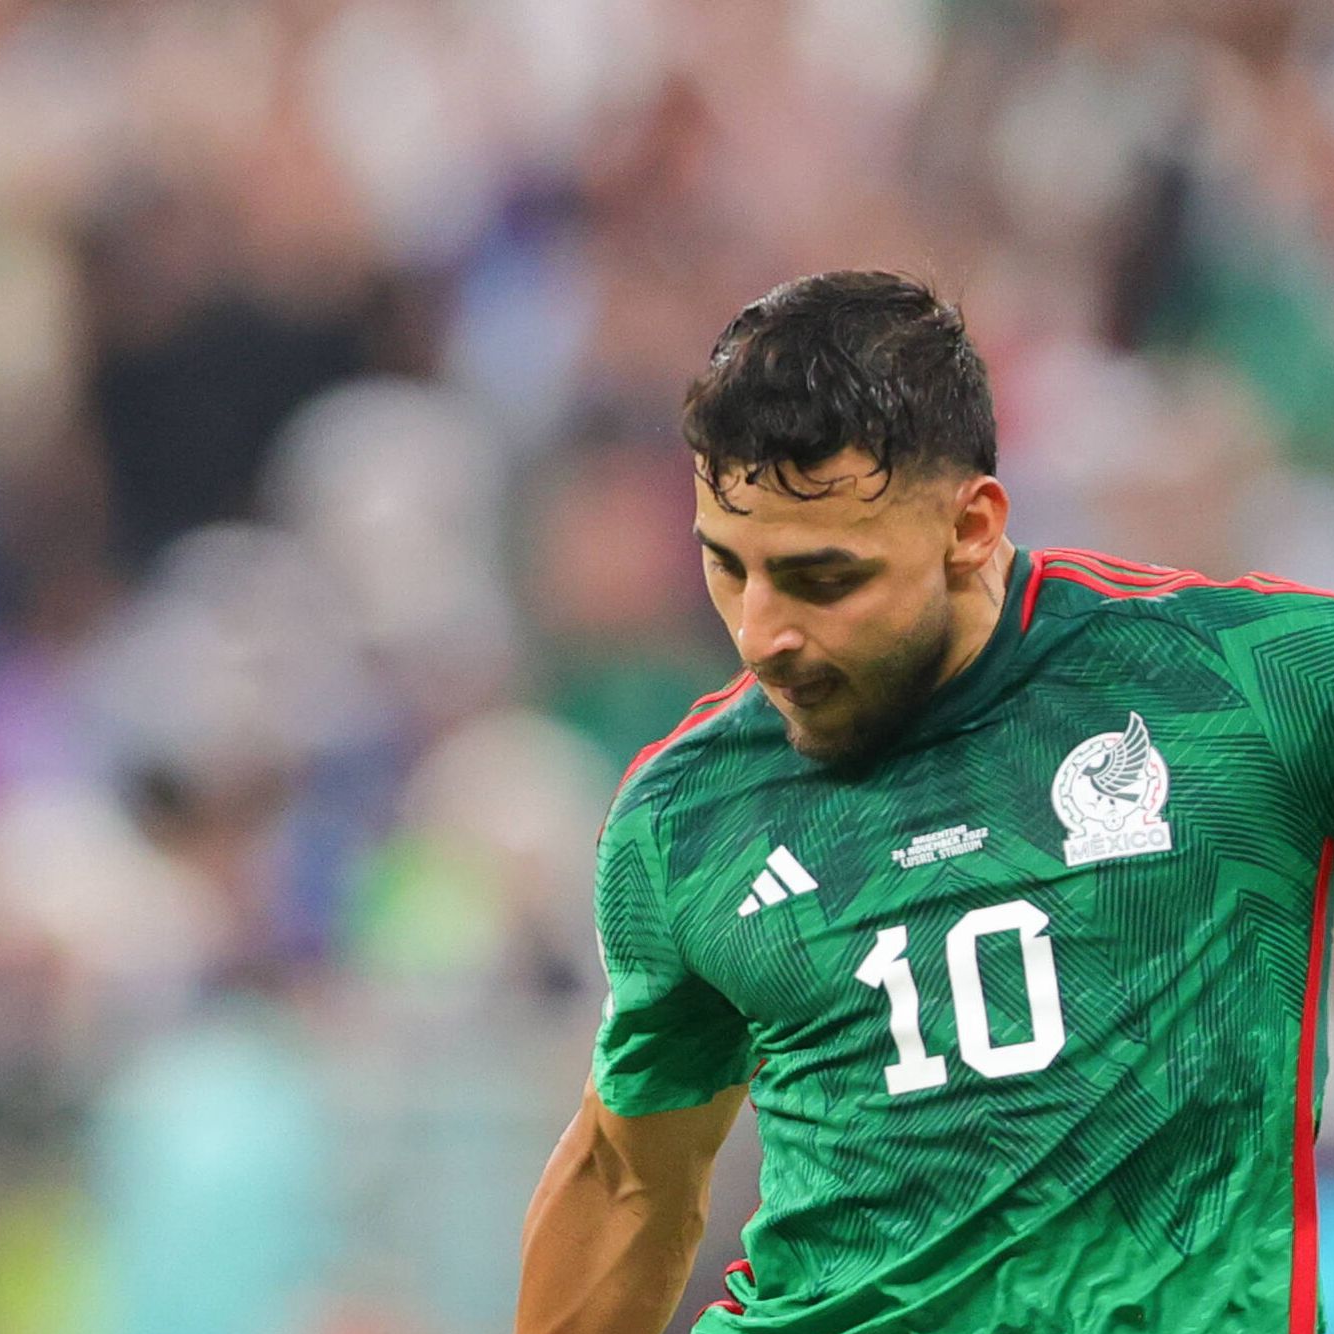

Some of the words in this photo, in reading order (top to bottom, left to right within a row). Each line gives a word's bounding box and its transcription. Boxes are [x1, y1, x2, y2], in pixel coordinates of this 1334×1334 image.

[907, 835, 961, 857] NOVEMBER
[961, 827, 989, 842] 2022
[912, 824, 967, 846] ARGENTINA
[938, 839, 983, 859] STADIUM
[1069, 828, 1167, 862] MÉXICO
[854, 899, 1066, 1095] 10
